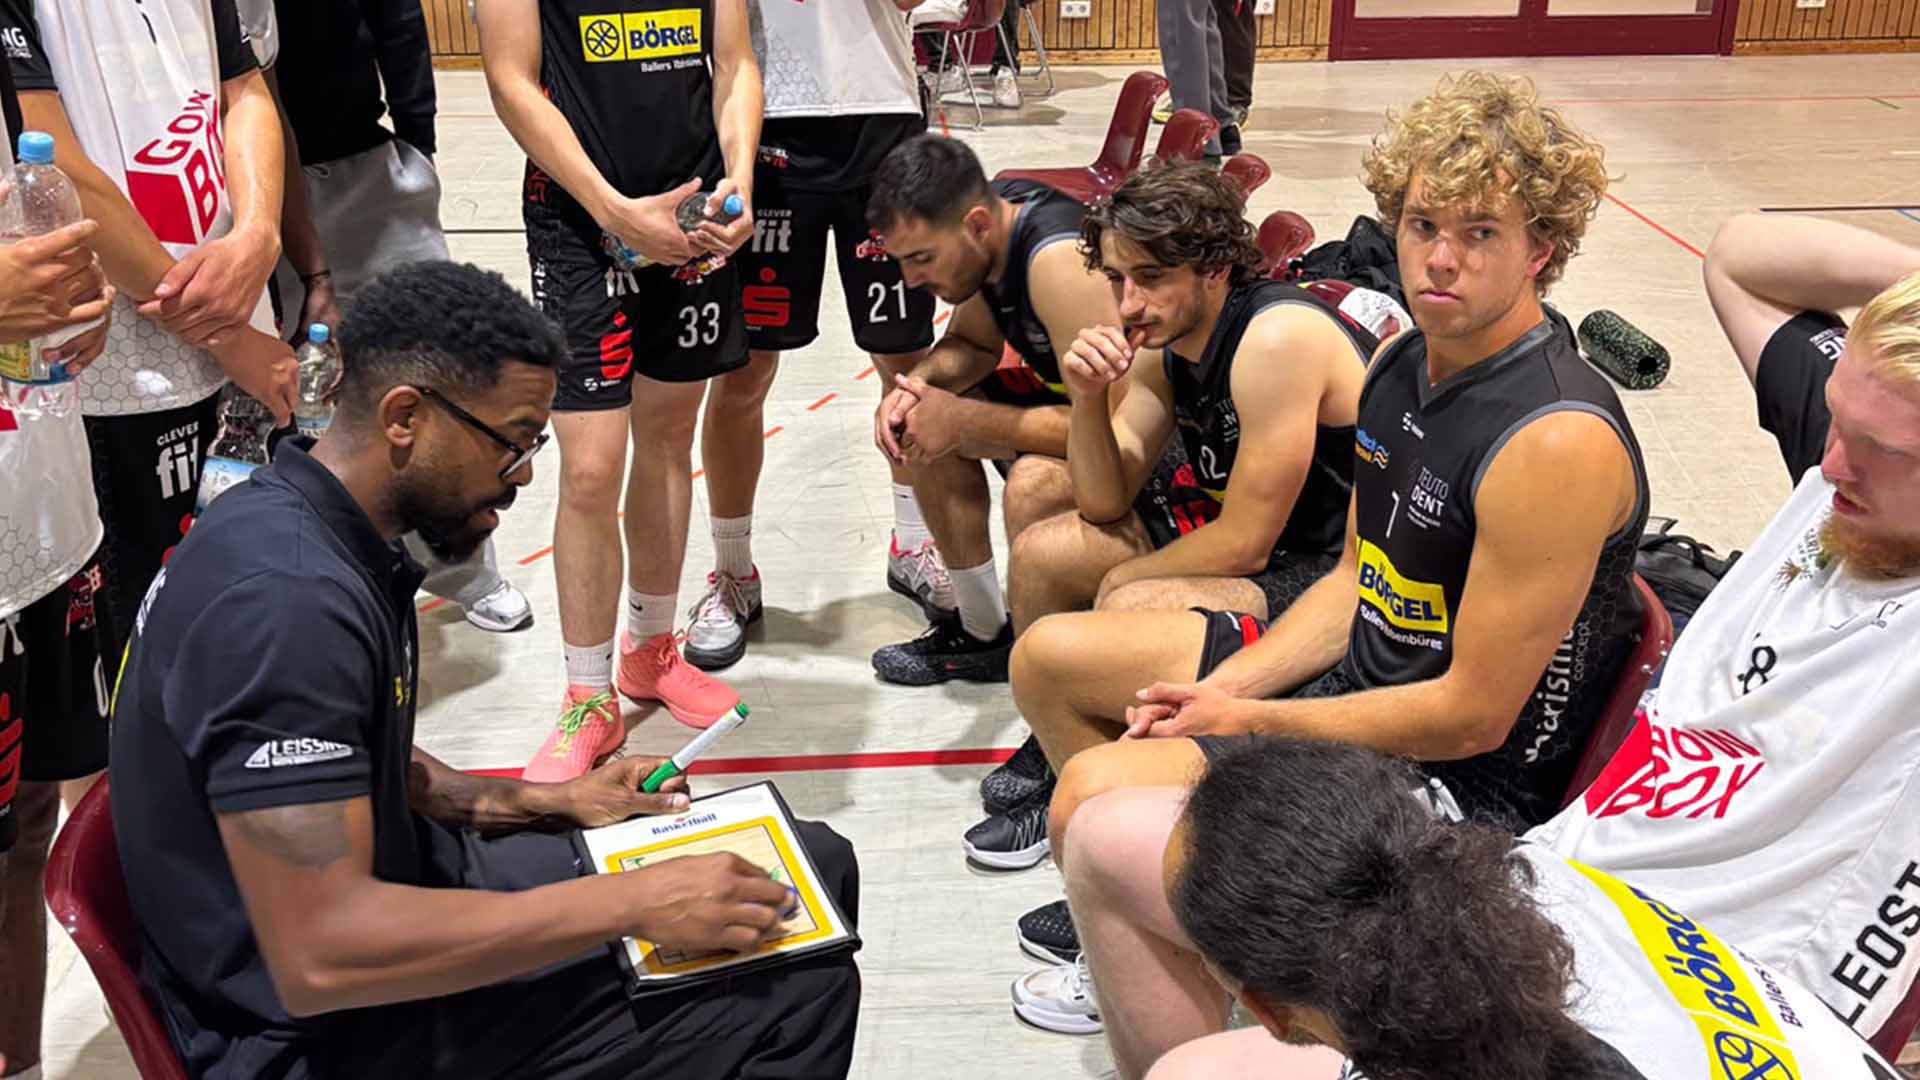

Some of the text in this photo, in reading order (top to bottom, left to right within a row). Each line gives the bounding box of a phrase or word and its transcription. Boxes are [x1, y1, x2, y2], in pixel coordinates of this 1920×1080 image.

[629, 19, 699, 50] BÖRGEL
[751, 219, 792, 253] fit
[867, 279, 907, 324] 21
[678, 301, 721, 348] 33
[1385, 490, 1401, 539] 7
[1411, 484, 1445, 517] DENT
[1595, 757, 1766, 820] BOX
